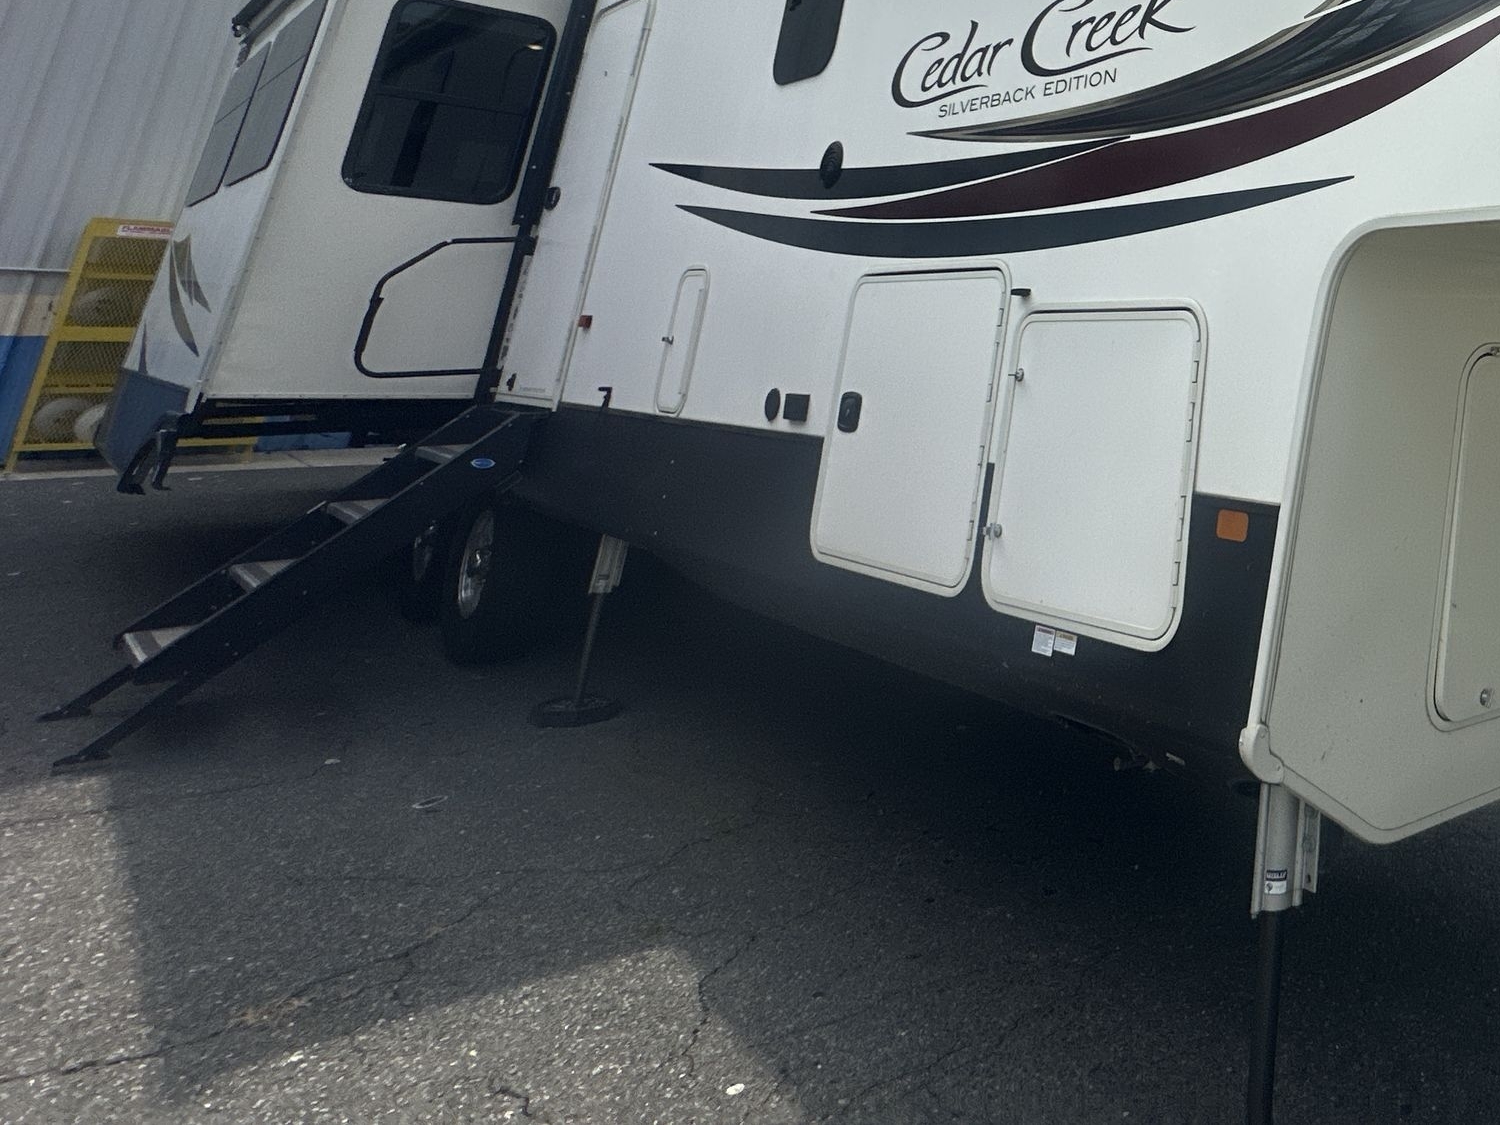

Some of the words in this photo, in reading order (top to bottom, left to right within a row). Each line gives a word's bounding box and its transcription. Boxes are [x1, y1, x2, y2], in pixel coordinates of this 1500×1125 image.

[891, 20, 1014, 109] Cedar
[937, 85, 1037, 118] SILVERBACK
[1043, 68, 1118, 97] EDITION
